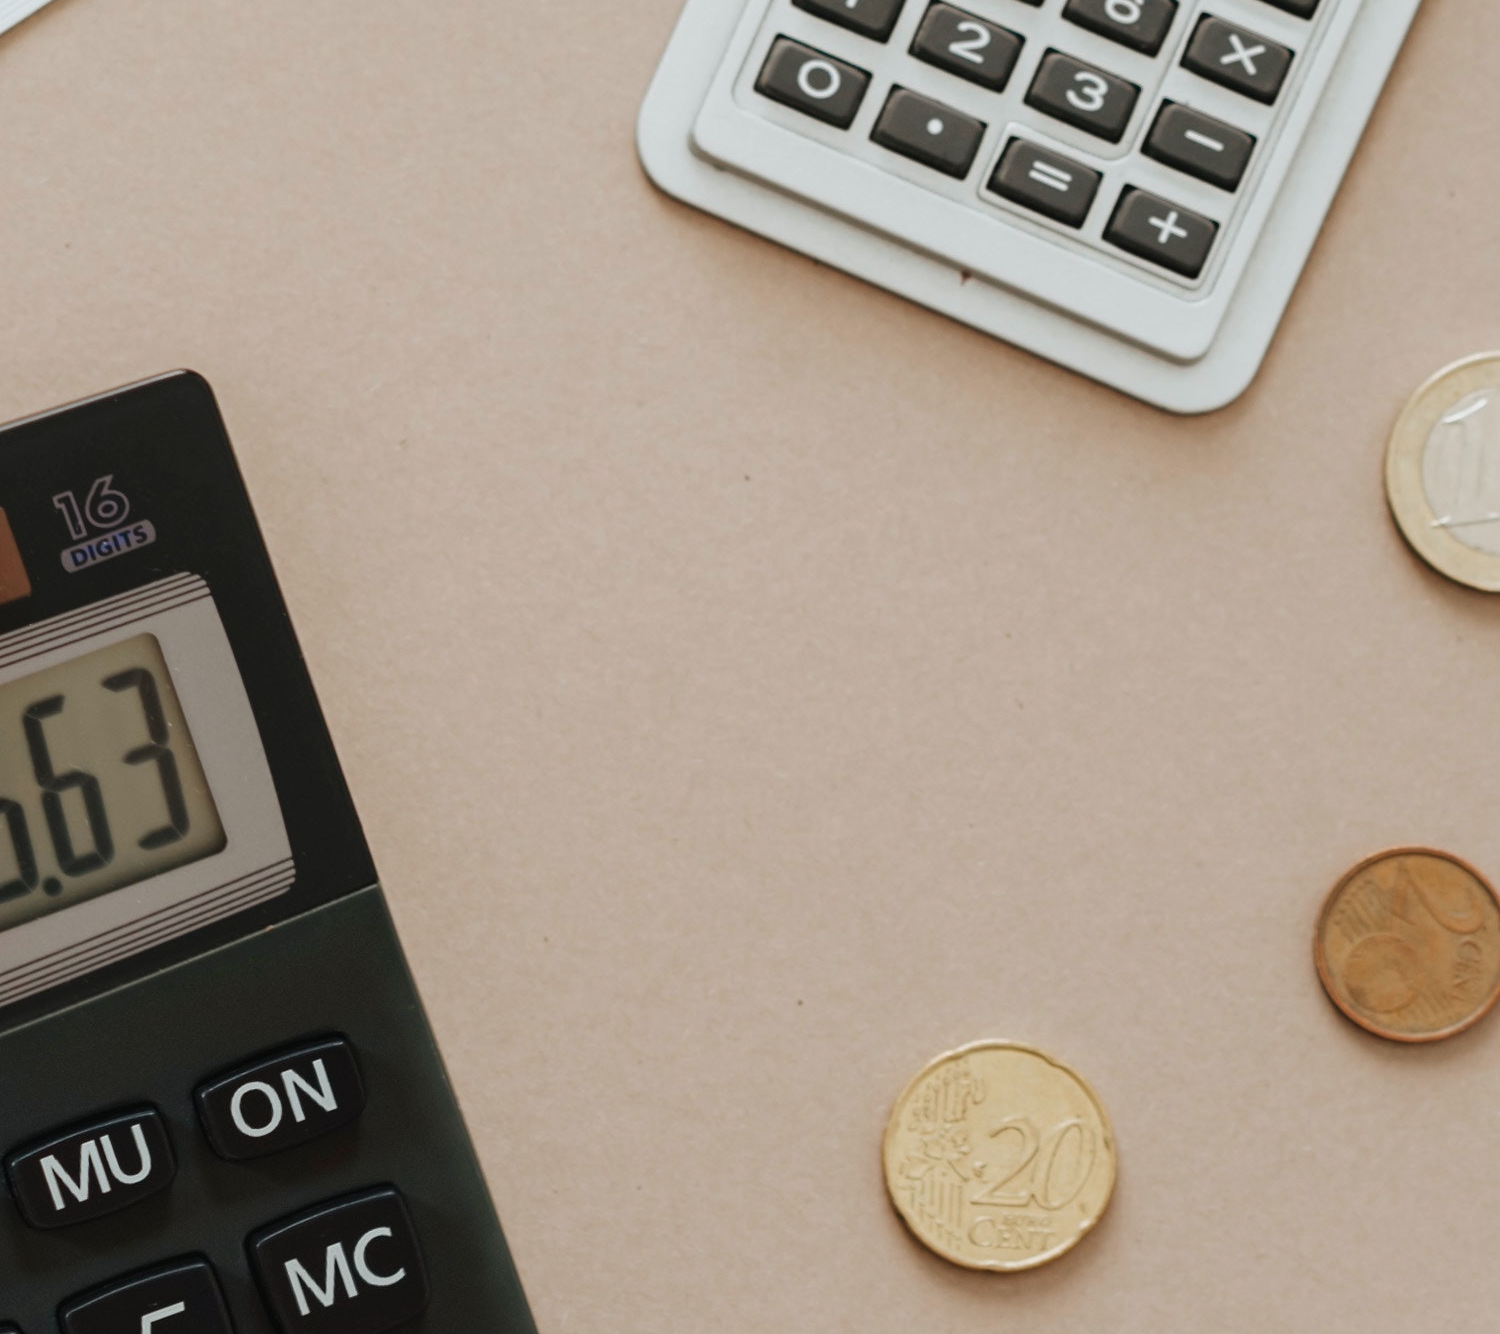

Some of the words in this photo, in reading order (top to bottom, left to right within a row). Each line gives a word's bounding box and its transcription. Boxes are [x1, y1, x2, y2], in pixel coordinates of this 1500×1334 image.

[797, 59, 841, 99] 0
[948, 21, 991, 64] 2
[1066, 71, 1109, 112] 3
[1429, 397, 1500, 528] 1
[52, 474, 130, 540] 16
[70, 524, 148, 566] DIGITS
[1390, 856, 1484, 937] 2
[39, 1123, 152, 1211] MU
[230, 1058, 338, 1138] ON
[969, 1118, 1096, 1210] 20
[284, 1226, 406, 1316] MC
[966, 1221, 1055, 1250] CENT
